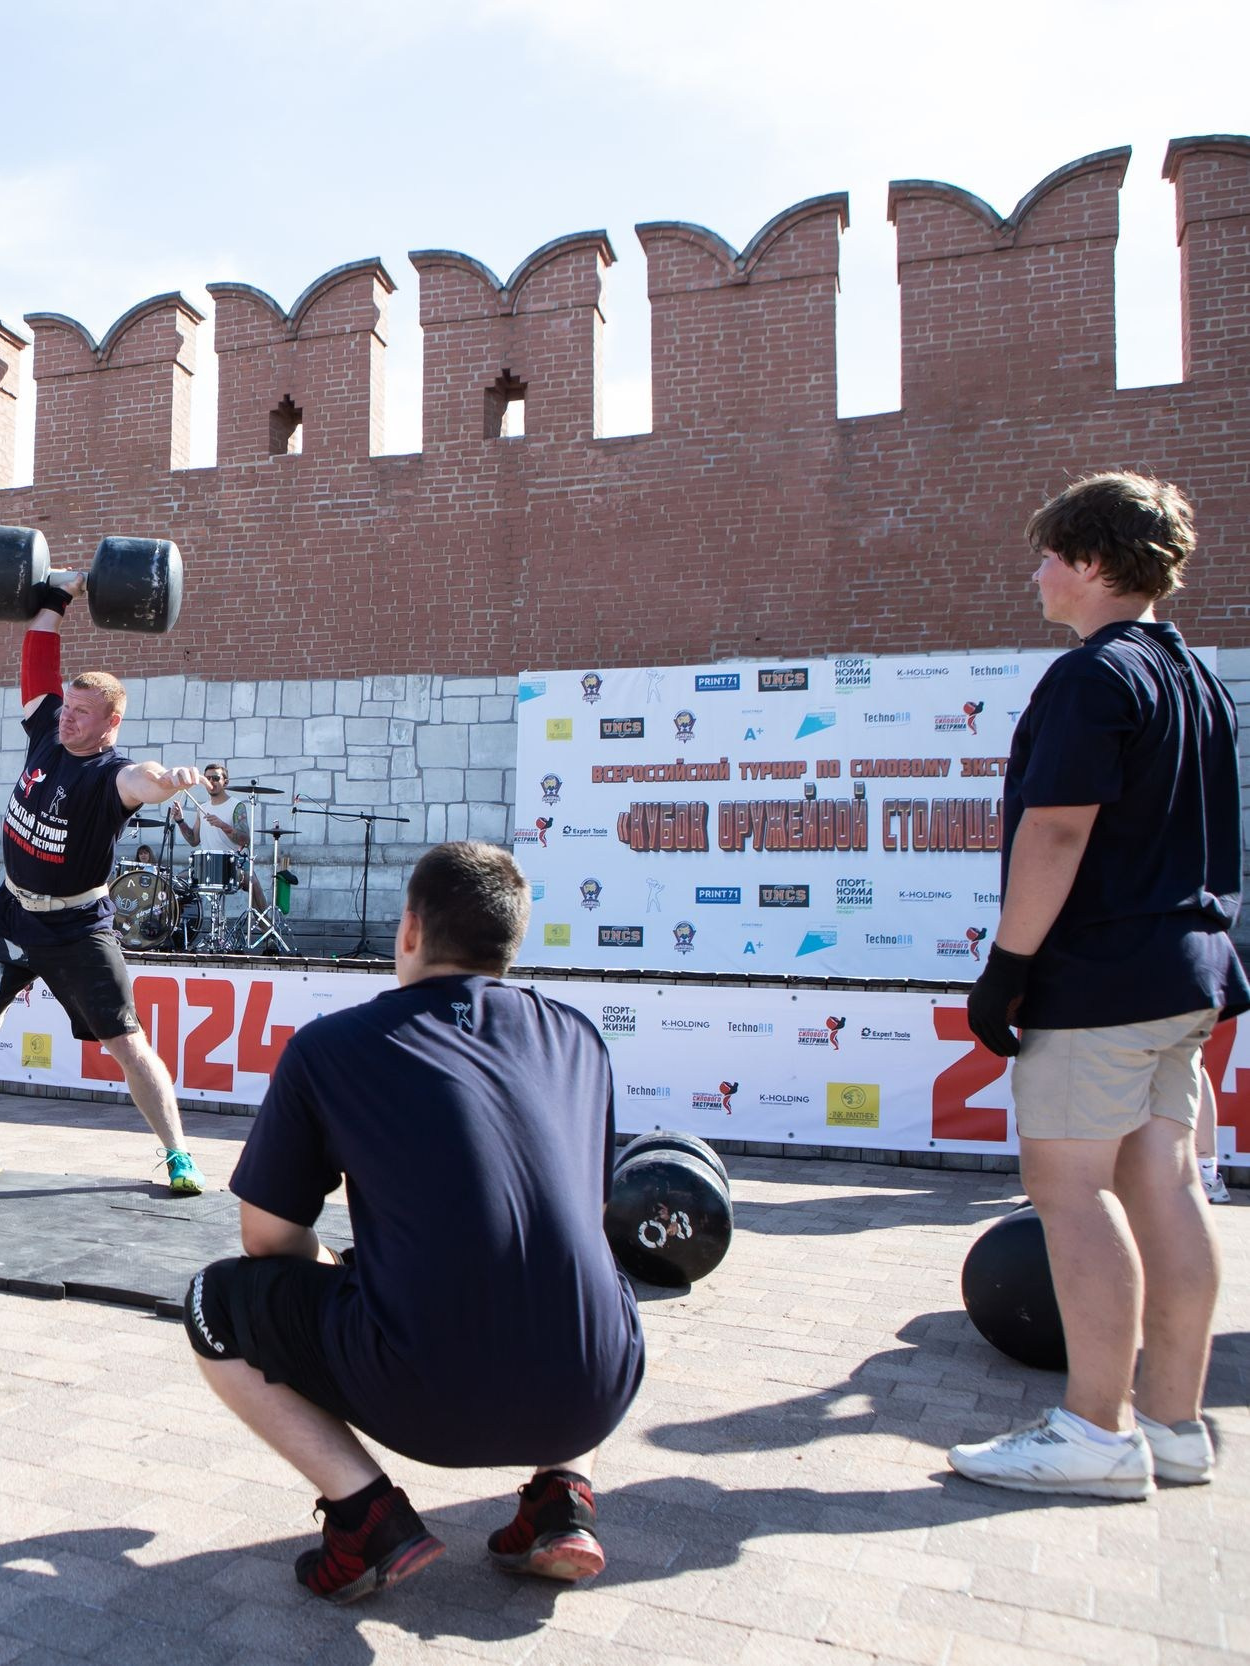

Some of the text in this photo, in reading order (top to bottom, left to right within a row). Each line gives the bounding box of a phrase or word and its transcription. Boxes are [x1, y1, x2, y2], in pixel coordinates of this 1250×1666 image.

[835, 659, 864, 668] СПОРТ
[835, 667, 871, 676] НОРМА
[897, 667, 949, 676] K-HOLDING
[698, 676, 738, 686] PRINT 71
[760, 673, 805, 685] UNCS
[834, 676, 871, 685] ЖИЗНИ
[603, 722, 642, 733] UNCS
[592, 757, 1007, 783] ВСЕРОССИЙСКИЙ ТУРНИР ПО СИЛОВОМУ ЭКСТ
[9, 793, 68, 842] КРЫТЫЙ ТУРНИР
[718, 781, 869, 852] ОРУЖЕЙНОЙ
[32, 835, 66, 854] ЭКСТРИМУ
[836, 879, 866, 887] СПОРТ
[699, 889, 739, 898] PRINT 71
[762, 889, 807, 901] UNCS
[836, 887, 873, 896] НОРМА
[899, 891, 952, 899] K-HOLDING
[836, 896, 873, 905] ЖИЗНИ
[973, 892, 1000, 903] Techn
[600, 930, 641, 941] UNCS
[602, 1006, 630, 1014] СПОРТ
[602, 1014, 636, 1023] НОРМА
[602, 1023, 636, 1032] ЖИЗНИ
[661, 1020, 710, 1029] K-HOLDING
[728, 1021, 774, 1033] TechnoAIR
[81, 976, 295, 1092] 024
[872, 1031, 893, 1039] Expert
[626, 1084, 671, 1096] TechnoAIR
[759, 1094, 810, 1103] K-HOLDING
[191, 1271, 225, 1354] SSENTIALS
